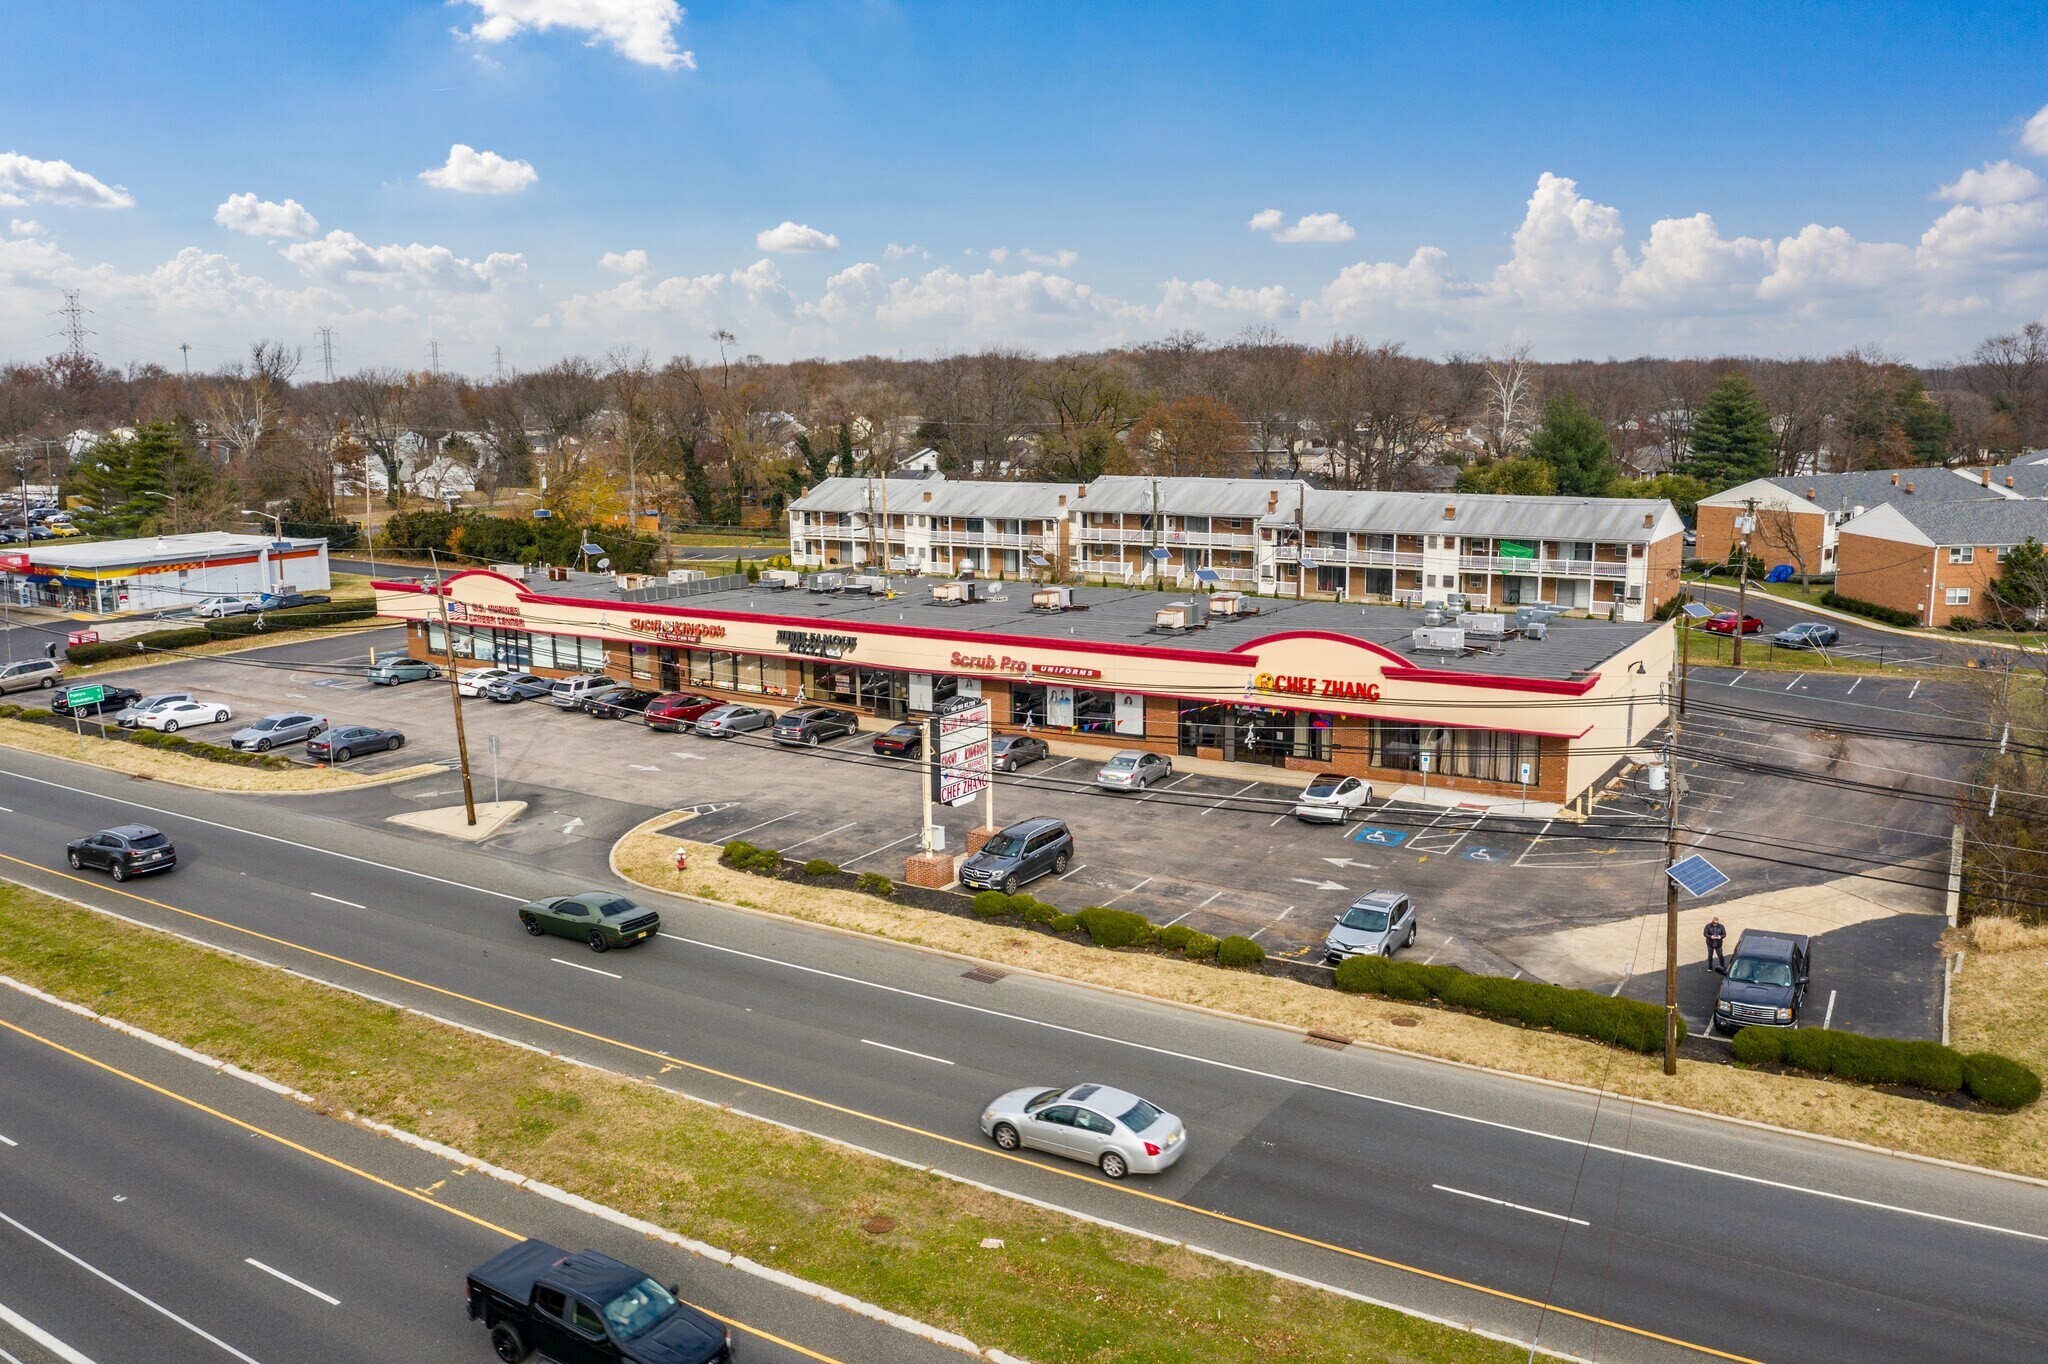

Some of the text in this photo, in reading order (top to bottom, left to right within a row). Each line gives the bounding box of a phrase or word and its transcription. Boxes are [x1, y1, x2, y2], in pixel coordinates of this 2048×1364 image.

[630, 618, 726, 638] SUSHI KINGDOM
[788, 642, 828, 658] PIZZA
[950, 651, 1094, 677] Scrub Pro UNIFORMS
[1275, 675, 1380, 702] CHEF ZHANG
[942, 772, 987, 801] CHEF ZHANG
